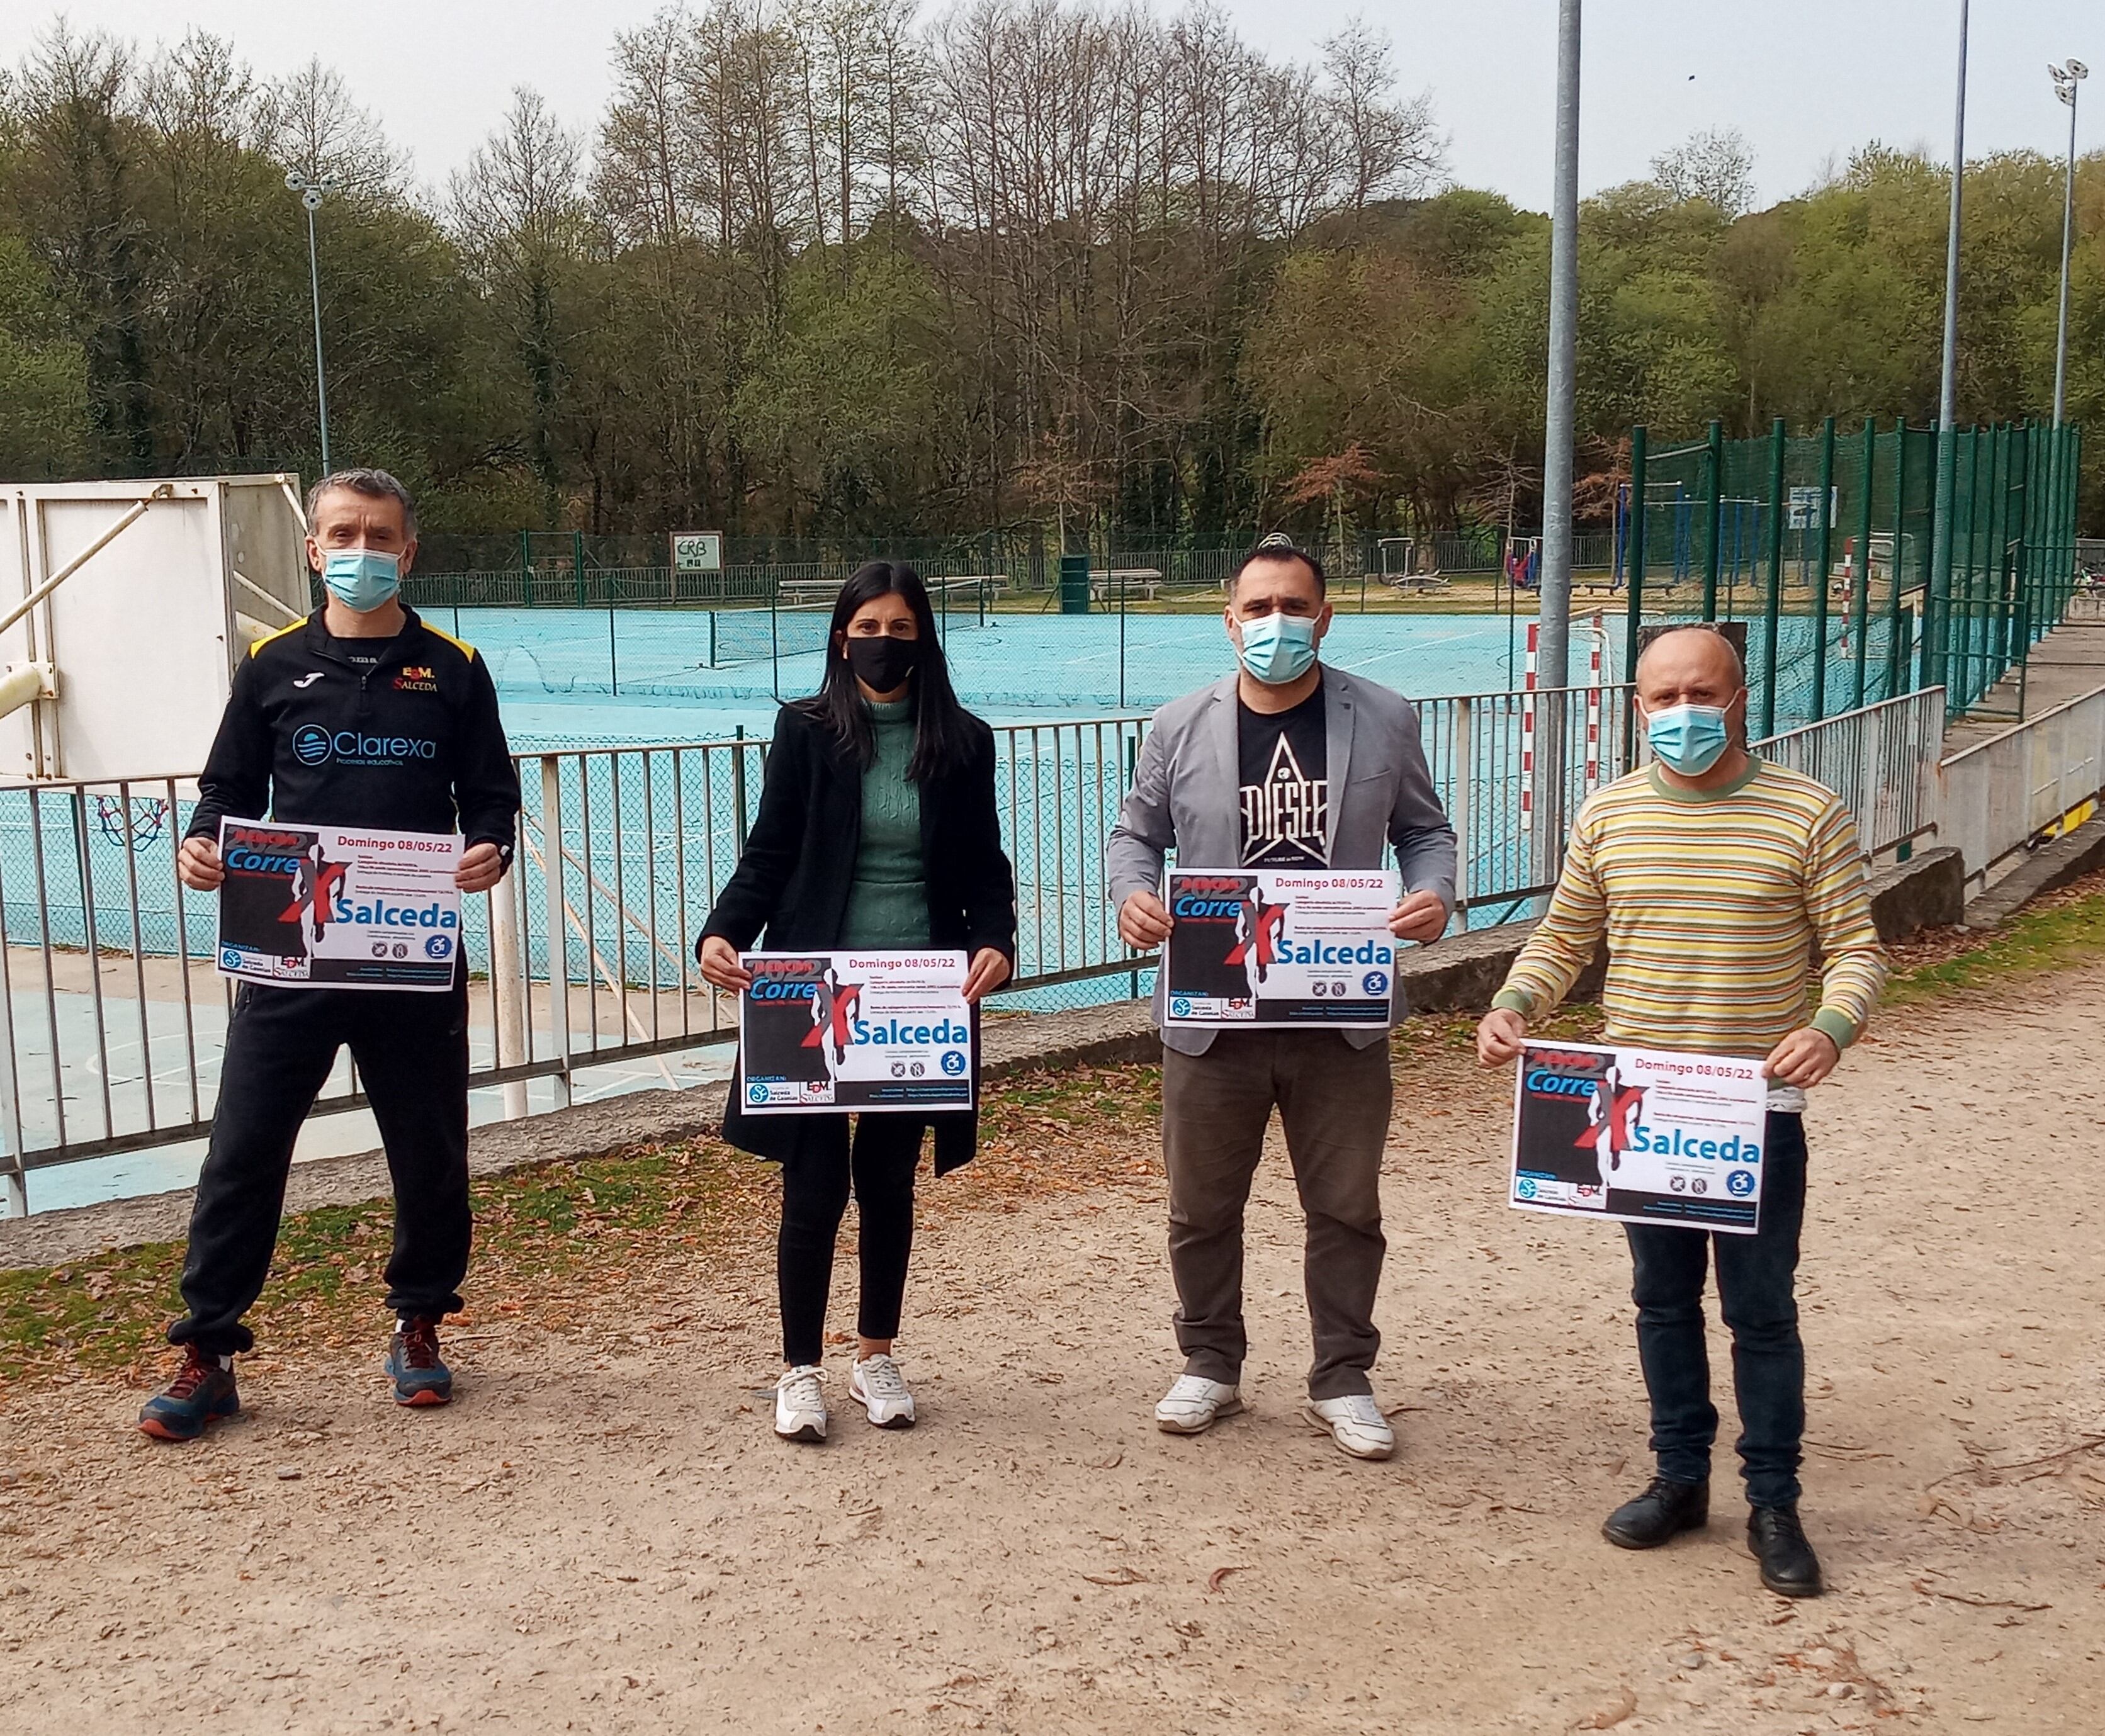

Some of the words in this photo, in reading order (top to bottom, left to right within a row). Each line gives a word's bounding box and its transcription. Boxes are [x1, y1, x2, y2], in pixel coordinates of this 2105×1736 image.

[334, 731, 436, 758] Clarexa
[225, 826, 308, 857] 2022
[338, 836, 395, 850] Domingo
[397, 840, 453, 853] 08/05/22
[227, 847, 301, 874] Corre
[1172, 876, 1248, 899] 2022
[1275, 877, 1328, 889] Domingo
[1332, 879, 1383, 889] 08/05/22
[336, 899, 457, 928] Salceda
[1175, 895, 1243, 916] Corre
[1277, 940, 1392, 964] Salceda
[746, 959, 822, 982] 2022
[849, 958, 902, 971] Domingo
[905, 958, 956, 968] 08/05/22
[750, 978, 817, 999] Corre
[854, 1018, 968, 1046] Salceda
[1635, 1058, 1693, 1076] Domingo
[1696, 1064, 1754, 1080] 08/05/22
[1527, 1069, 1598, 1096] Corre
[1634, 1127, 1760, 1163] Salceda
